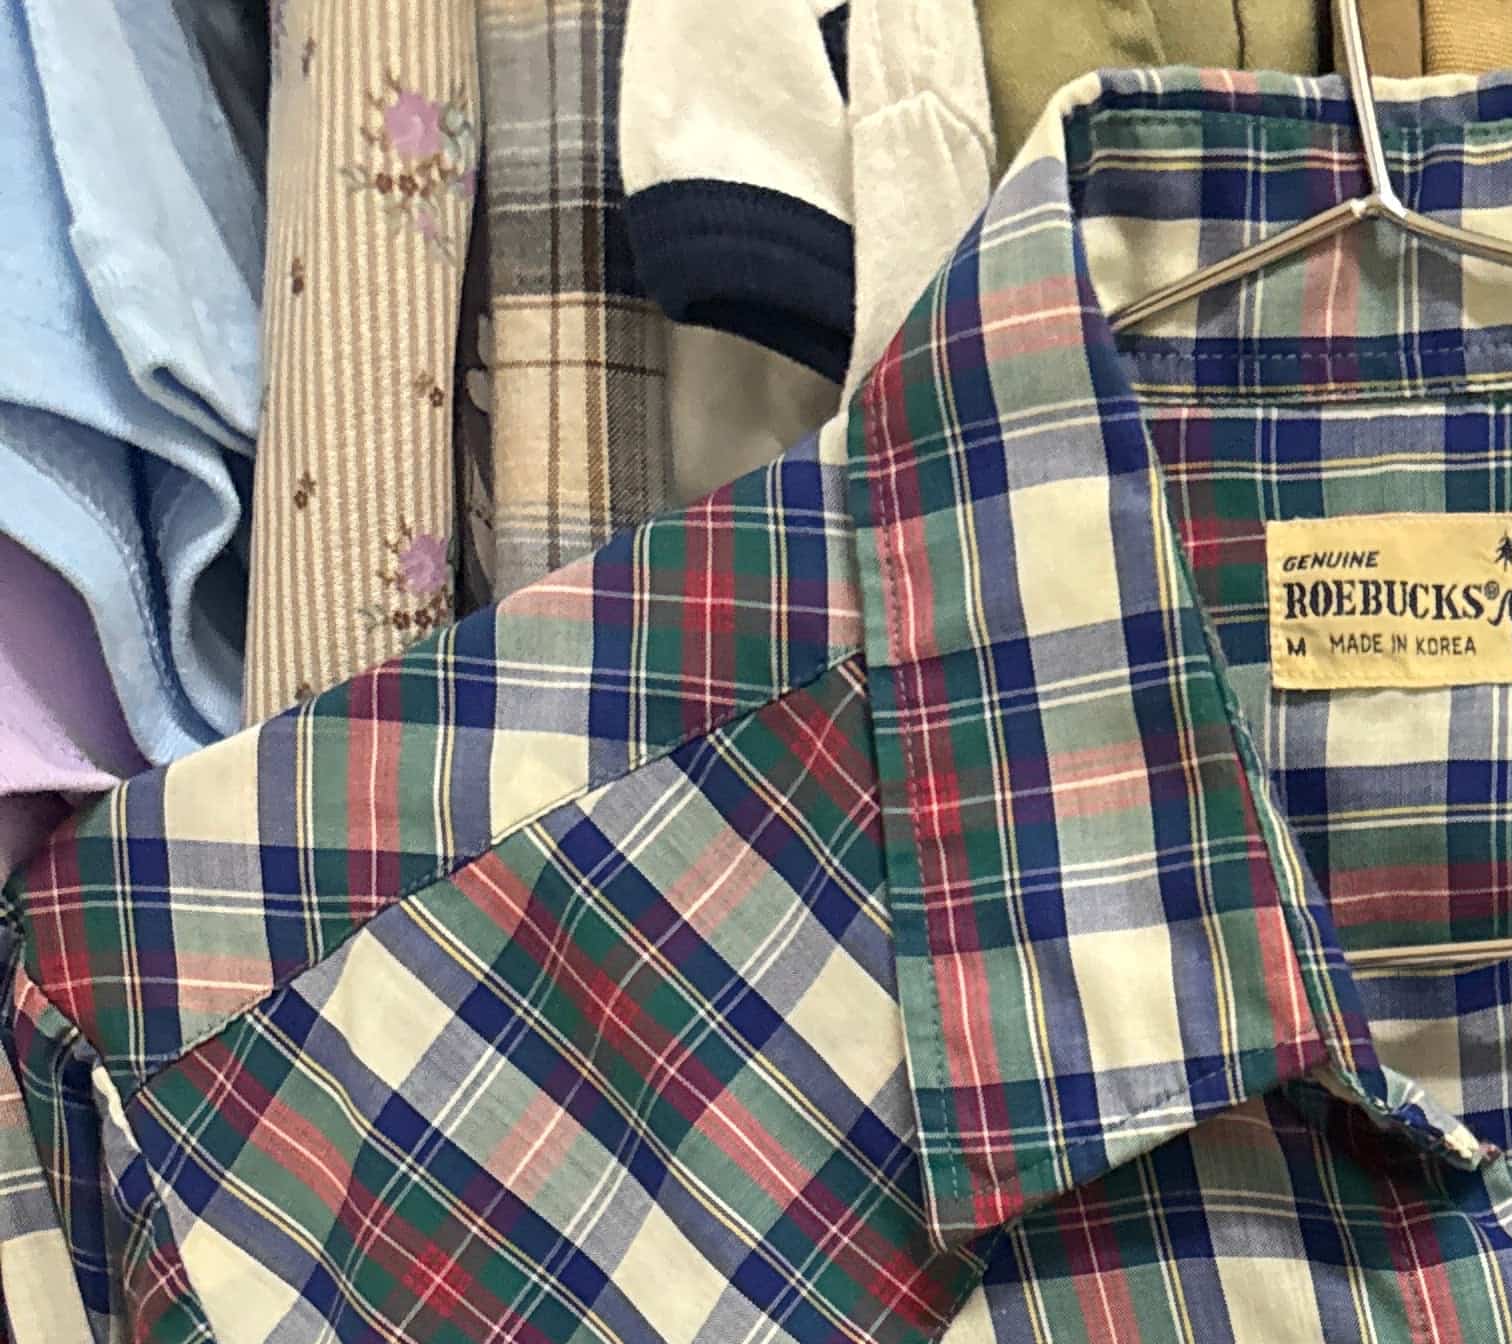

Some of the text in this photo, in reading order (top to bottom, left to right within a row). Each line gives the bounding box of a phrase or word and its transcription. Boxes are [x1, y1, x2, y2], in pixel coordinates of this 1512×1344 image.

[1283, 551, 1379, 572] GENUINE
[1286, 637, 1307, 657] M
[1329, 632, 1477, 656] MADE IN KOREA
